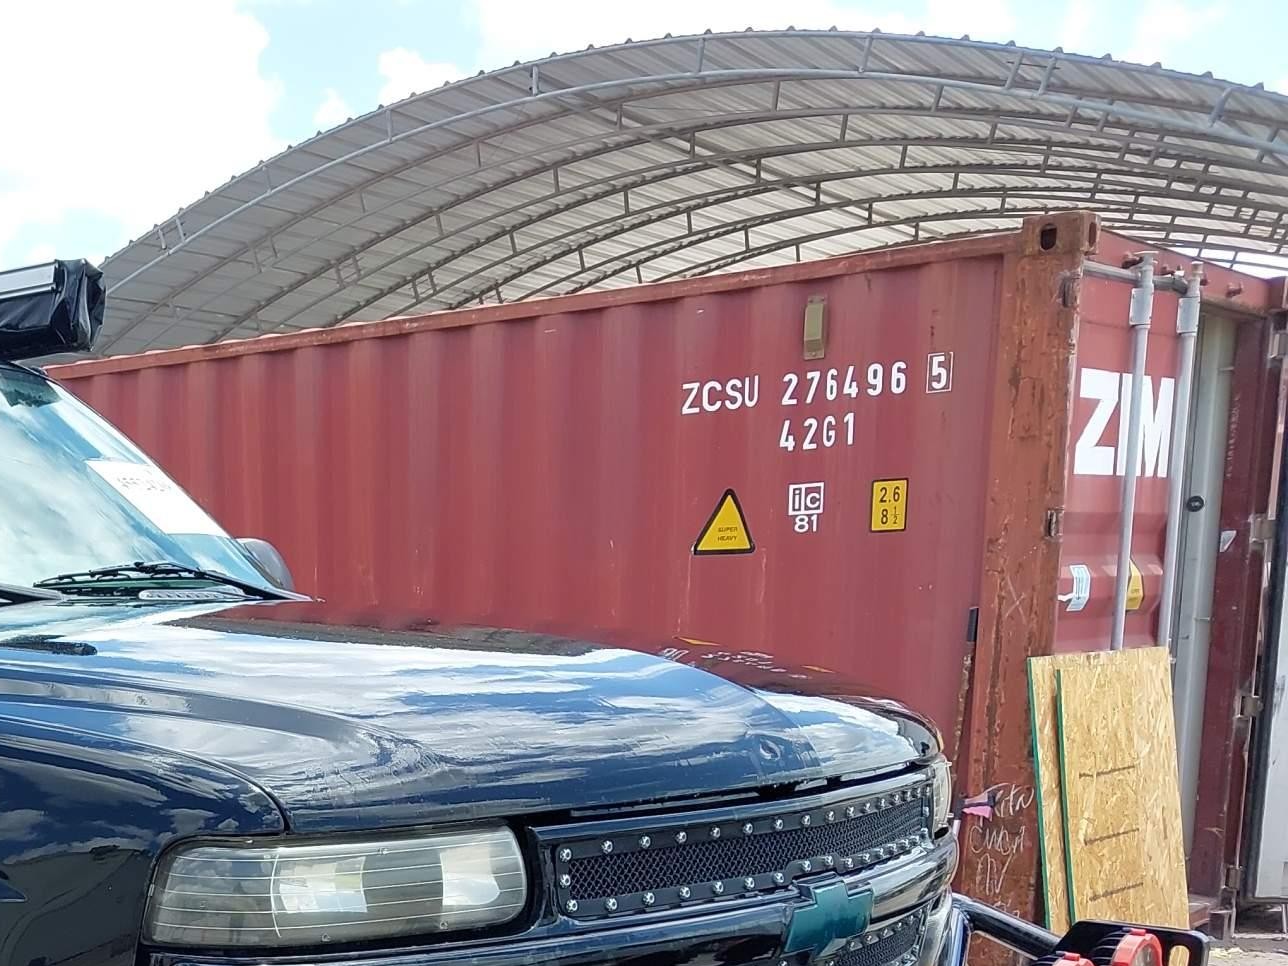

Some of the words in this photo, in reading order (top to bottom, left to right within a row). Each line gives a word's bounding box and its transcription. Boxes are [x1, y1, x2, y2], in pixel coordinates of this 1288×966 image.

[681, 375, 759, 415] ZCSU
[781, 361, 907, 406] 276496
[930, 353, 949, 392] 5
[779, 412, 855, 452] 42G1
[1073, 367, 1175, 478] ZIM
[878, 485, 901, 504] 2.6
[793, 513, 818, 533] 81
